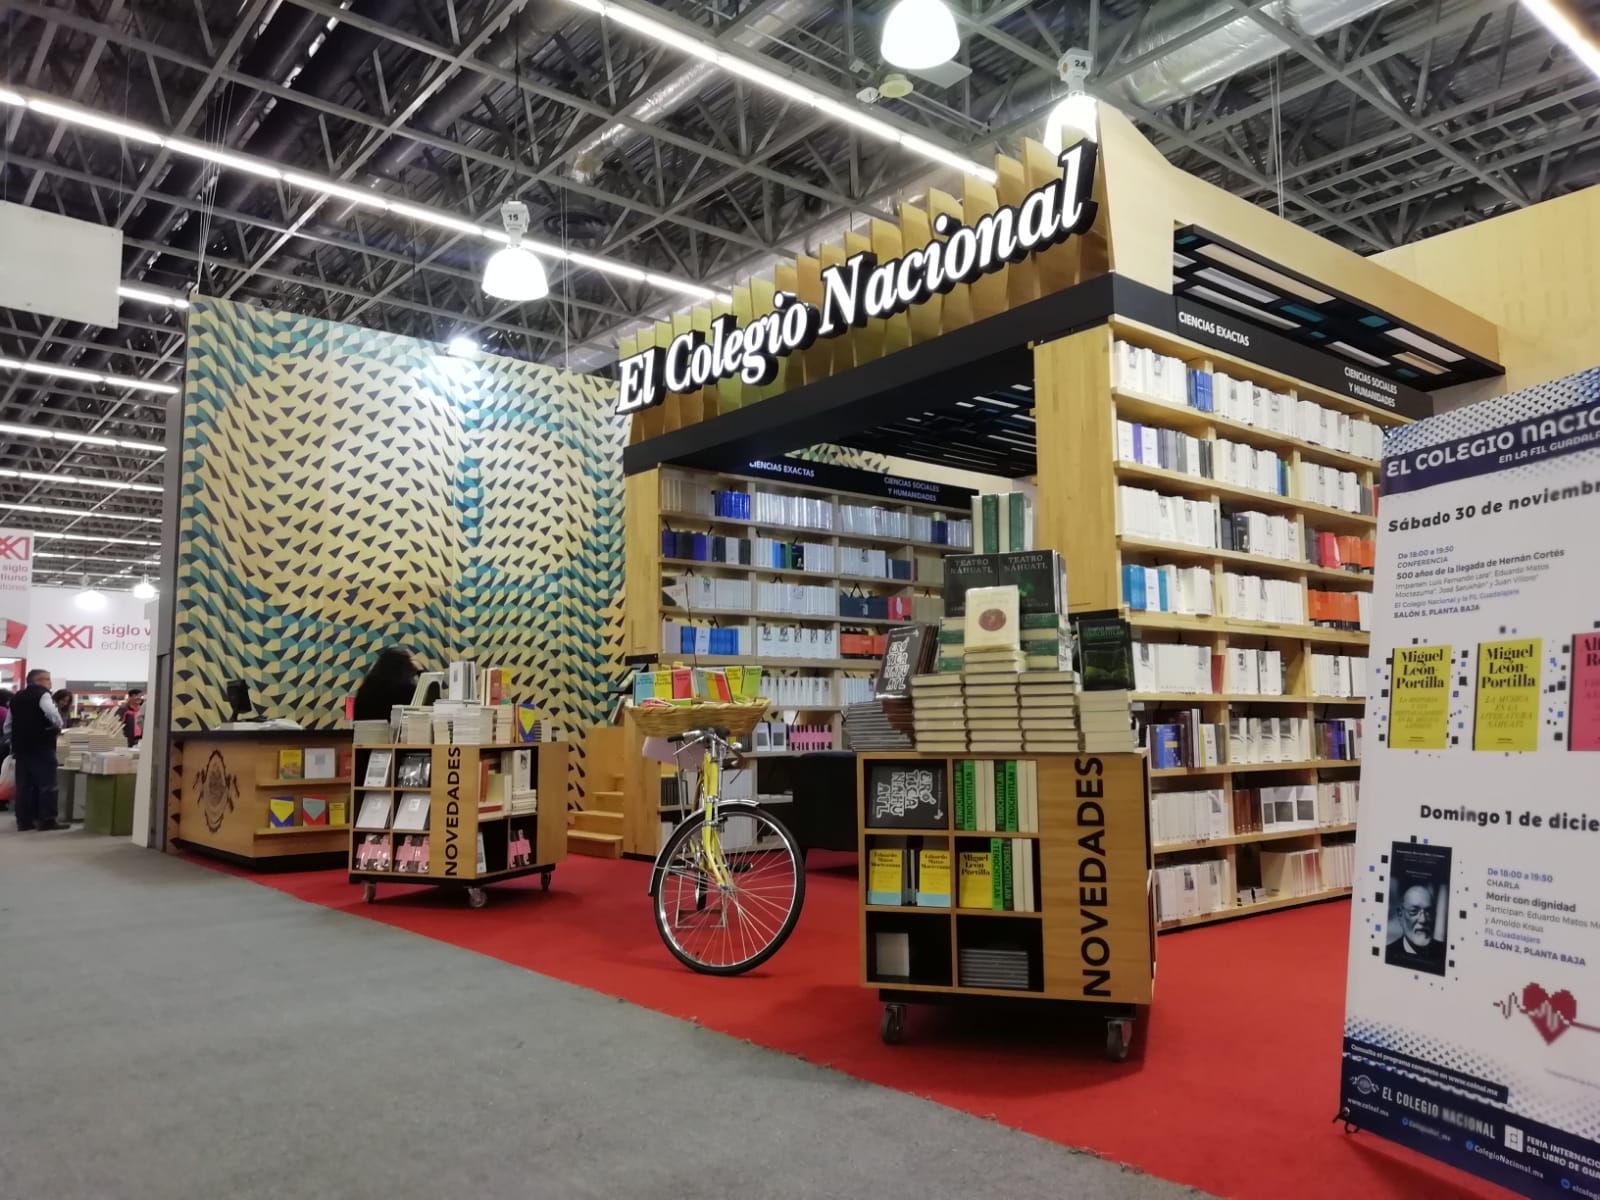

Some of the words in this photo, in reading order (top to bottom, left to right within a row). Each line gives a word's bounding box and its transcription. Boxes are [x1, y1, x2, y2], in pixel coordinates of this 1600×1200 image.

[1074, 59, 1087, 70] 24
[616, 347, 658, 413] El
[665, 292, 812, 386] Colegio
[819, 140, 1096, 337] Nacional
[1178, 311, 1215, 334] CIENCIAS
[1216, 325, 1250, 347] EXACTAS
[1344, 366, 1371, 385] CIENCIAS
[1371, 377, 1398, 395] SOCIALES
[1348, 382, 1353, 392] Y
[1354, 384, 1396, 408] HUMANIDADES
[1386, 460, 1412, 478] EL
[1415, 431, 1515, 471] COLEGIO
[1498, 454, 1513, 464] EN
[1515, 450, 1528, 460] LA
[1530, 445, 1548, 456] FIL
[783, 465, 815, 478] EXACTAS
[883, 476, 912, 488] CIENCIAS
[912, 481, 940, 493] SOCIALES
[893, 488, 937, 502] HUMANIDADES
[1388, 512, 1451, 533] Sábado
[1455, 505, 1476, 521] 30
[1481, 500, 1503, 516] de
[1007, 554, 1044, 564] TEATRO
[1396, 571, 1413, 580] 500
[1414, 569, 1433, 578] años
[1435, 568, 1446, 576] de
[1447, 566, 1454, 574] la
[1456, 561, 1485, 573] llegada
[1486, 559, 1497, 567] de
[1499, 554, 1532, 566] Hernán
[1533, 548, 1565, 560] Cortés
[1397, 552, 1408, 560] De
[1397, 556, 1448, 569] CONFERENCIA
[1428, 606, 1459, 615] PLANTA
[102, 624, 141, 639] siglo
[1401, 649, 1443, 666] Miguel
[1487, 644, 1534, 665] Miguel
[1396, 676, 1444, 689] Portilla
[1481, 674, 1536, 689] Portilla
[445, 746, 461, 876] NOVEDADES
[1420, 805, 1500, 826] Domingo
[1505, 810, 1512, 825] 1
[1519, 811, 1542, 827] de
[1549, 812, 1600, 832] dicie
[1074, 757, 1111, 997] NOVEDADES
[1486, 878, 1520, 890] CHARLA
[1487, 868, 1498, 876] De
[1500, 868, 1522, 879] 18:00
[1530, 872, 1553, 883] 19:50
[1486, 891, 1511, 902] Morir
[1512, 896, 1530, 906] con
[1531, 898, 1576, 913] dignidad
[1527, 911, 1560, 923] Eduardo
[1483, 939, 1513, 951] SALÓN
[1524, 946, 1558, 961] PLANTA
[1560, 954, 1586, 966] BAJA
[1382, 1086, 1393, 1101] EL
[1396, 1091, 1439, 1118] COLEGIO
[1442, 1108, 1496, 1140] NACIONAL
[1526, 1135, 1548, 1150] FERIA
[1526, 1145, 1541, 1157] DEL
[1542, 1151, 1567, 1167] LIBRO
[1568, 1161, 1580, 1172] DE
